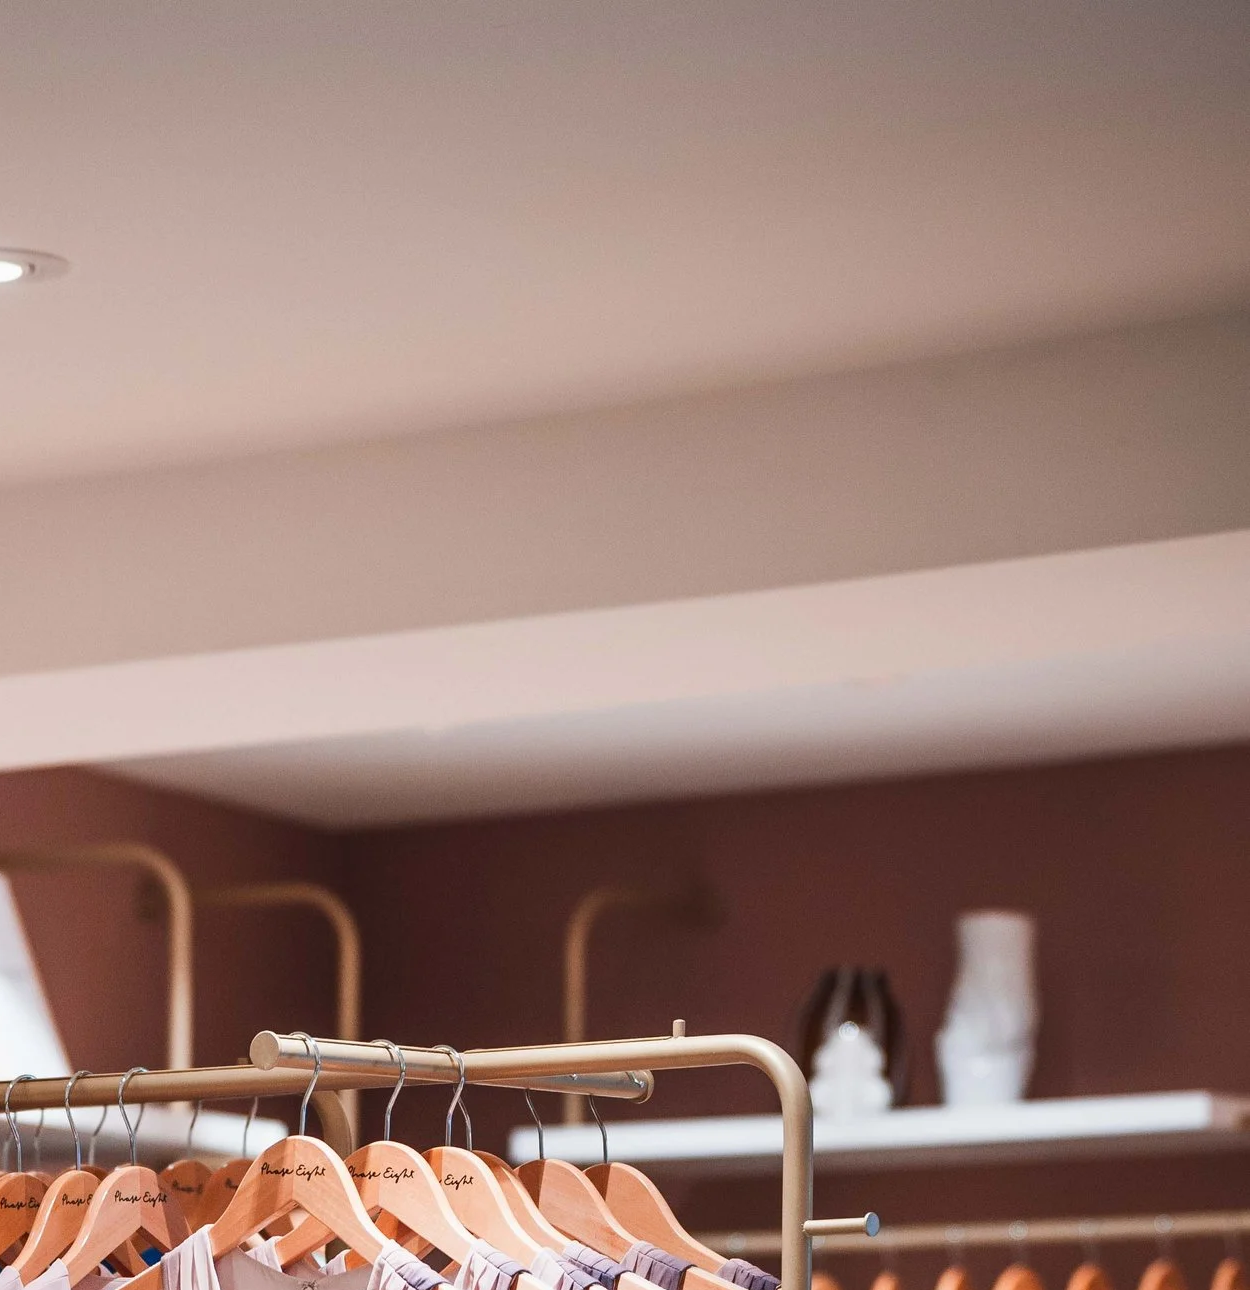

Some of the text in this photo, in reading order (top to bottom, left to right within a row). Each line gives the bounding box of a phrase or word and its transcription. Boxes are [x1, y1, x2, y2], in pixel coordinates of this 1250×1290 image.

[261, 1162, 326, 1182] Phase Eight
[382, 1167, 415, 1184] Eight
[443, 1174, 474, 1190] Eight
[0, 1197, 27, 1209] Phase
[61, 1193, 86, 1206] Phase
[114, 1190, 168, 1207] Phase Eight
